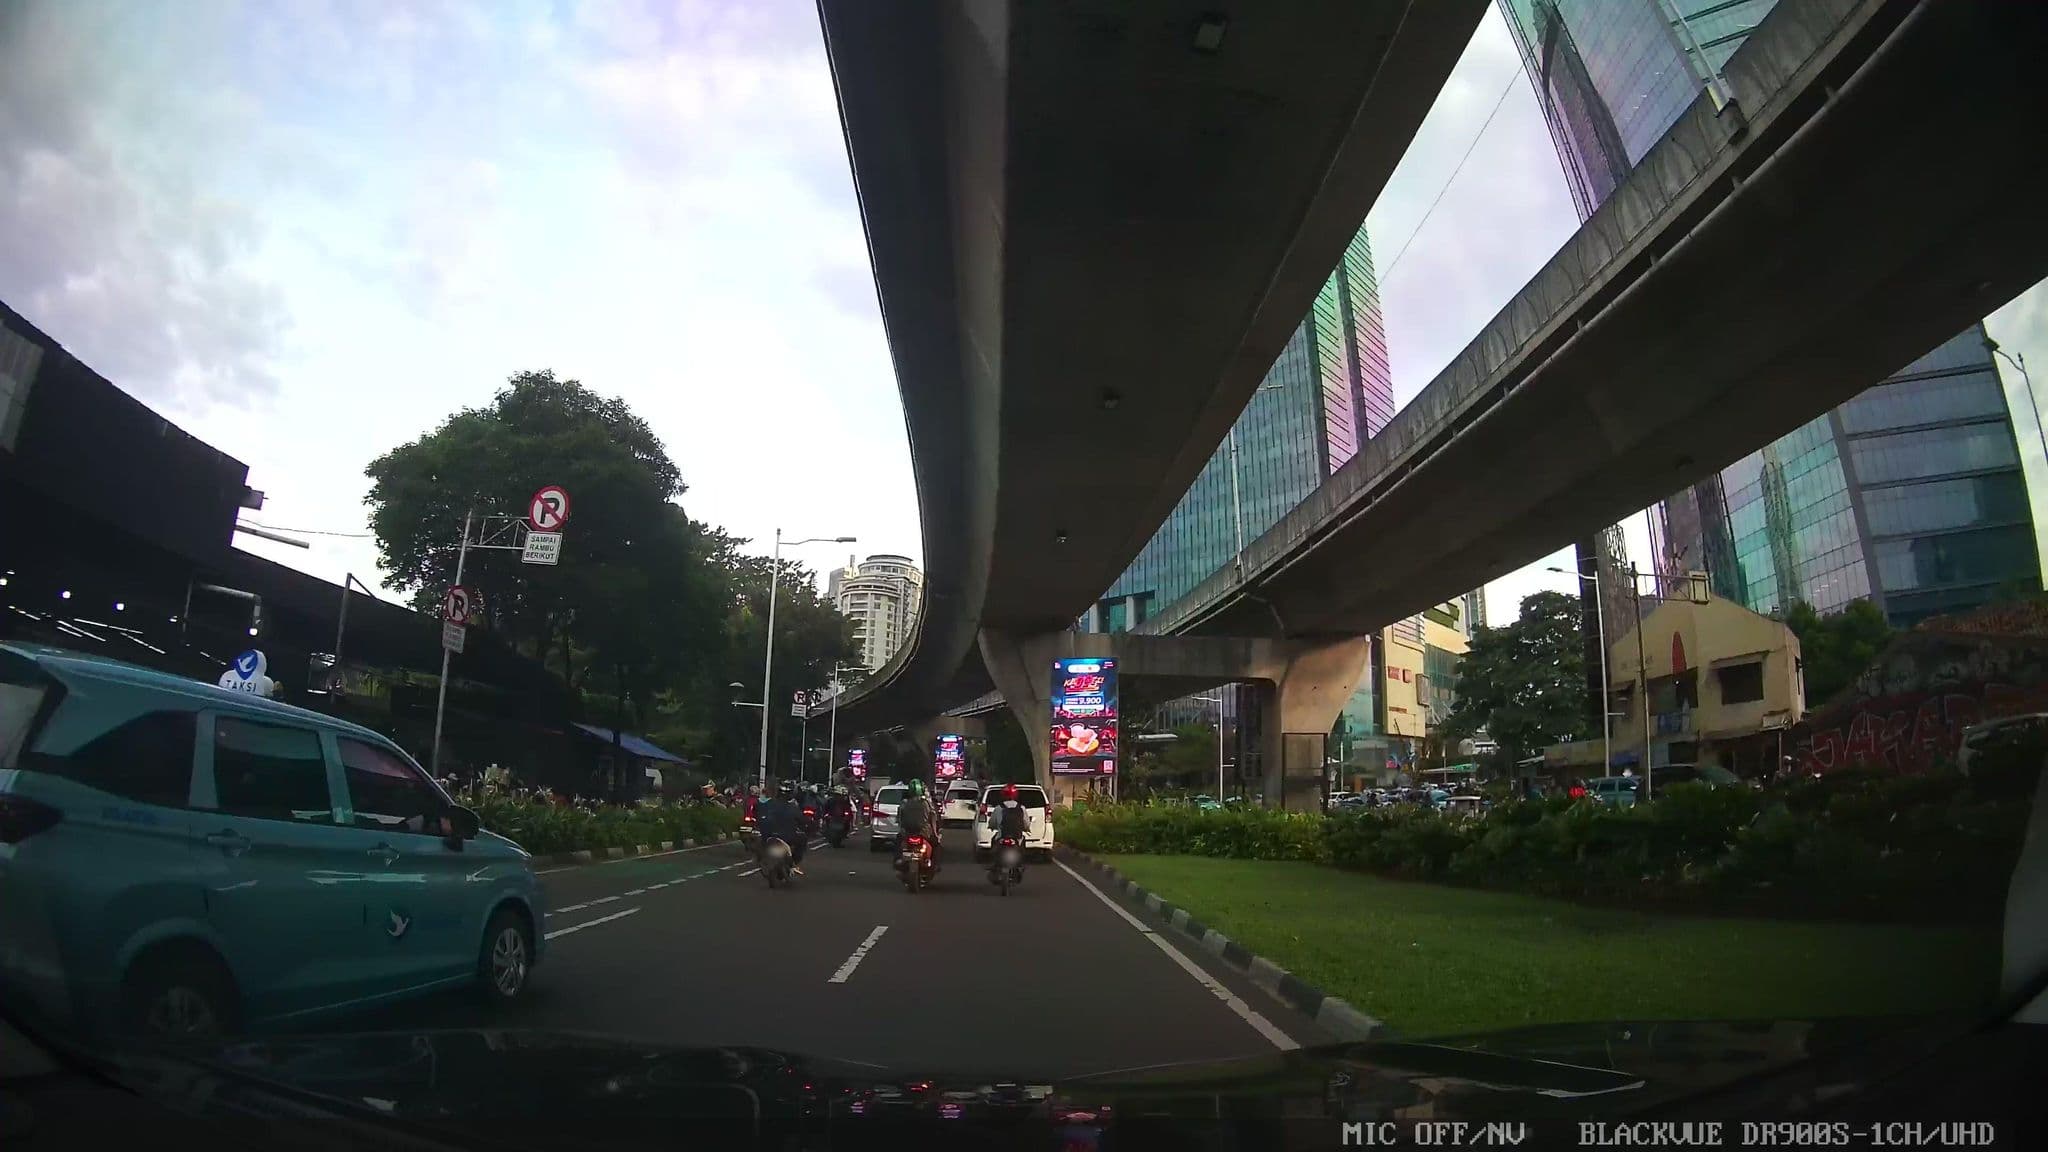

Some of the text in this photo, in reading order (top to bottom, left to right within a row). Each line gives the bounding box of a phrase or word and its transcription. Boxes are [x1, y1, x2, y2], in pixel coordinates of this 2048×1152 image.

[530, 535, 557, 544] SAMPAI
[529, 543, 555, 552] RAMBU
[525, 551, 555, 560] BERIKUT
[226, 679, 257, 692] TAKSI
